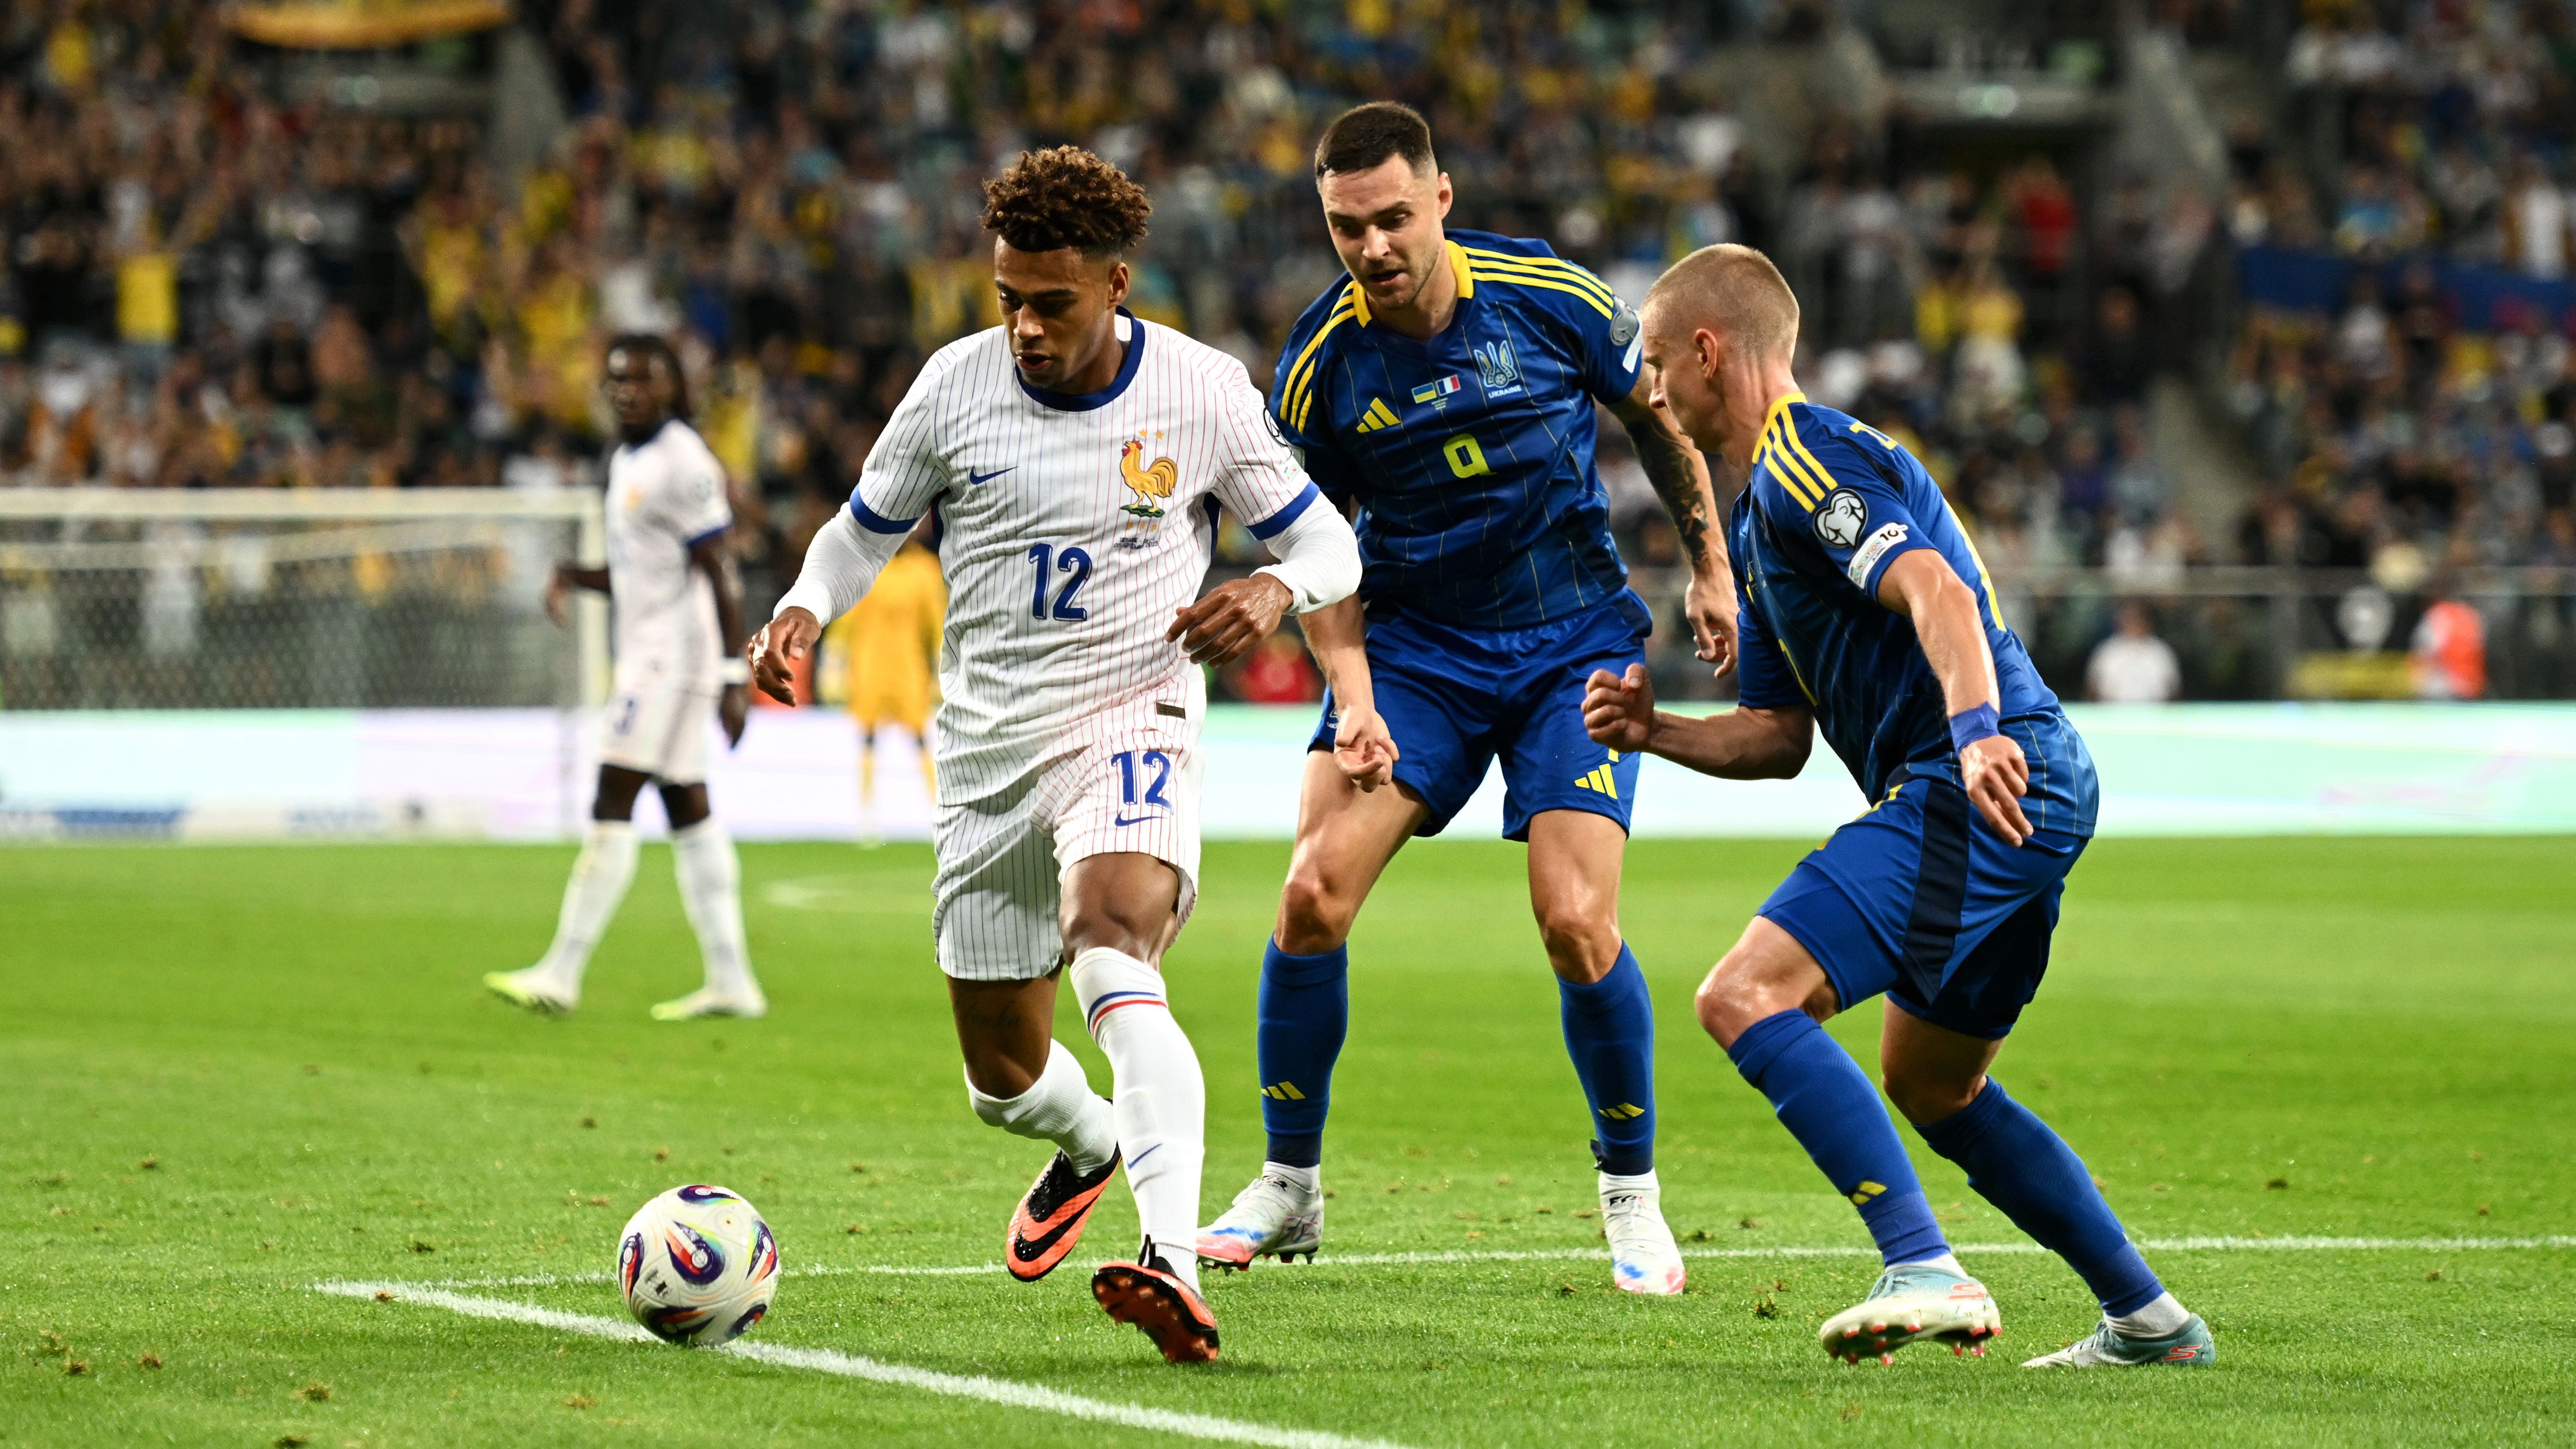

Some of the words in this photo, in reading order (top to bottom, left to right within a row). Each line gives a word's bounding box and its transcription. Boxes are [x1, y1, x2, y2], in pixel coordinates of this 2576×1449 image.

[1488, 385, 1522, 399] UKRAINE
[1443, 433, 1497, 478] 9
[1028, 543, 1093, 622] 12
[1110, 750, 1174, 816] 12
